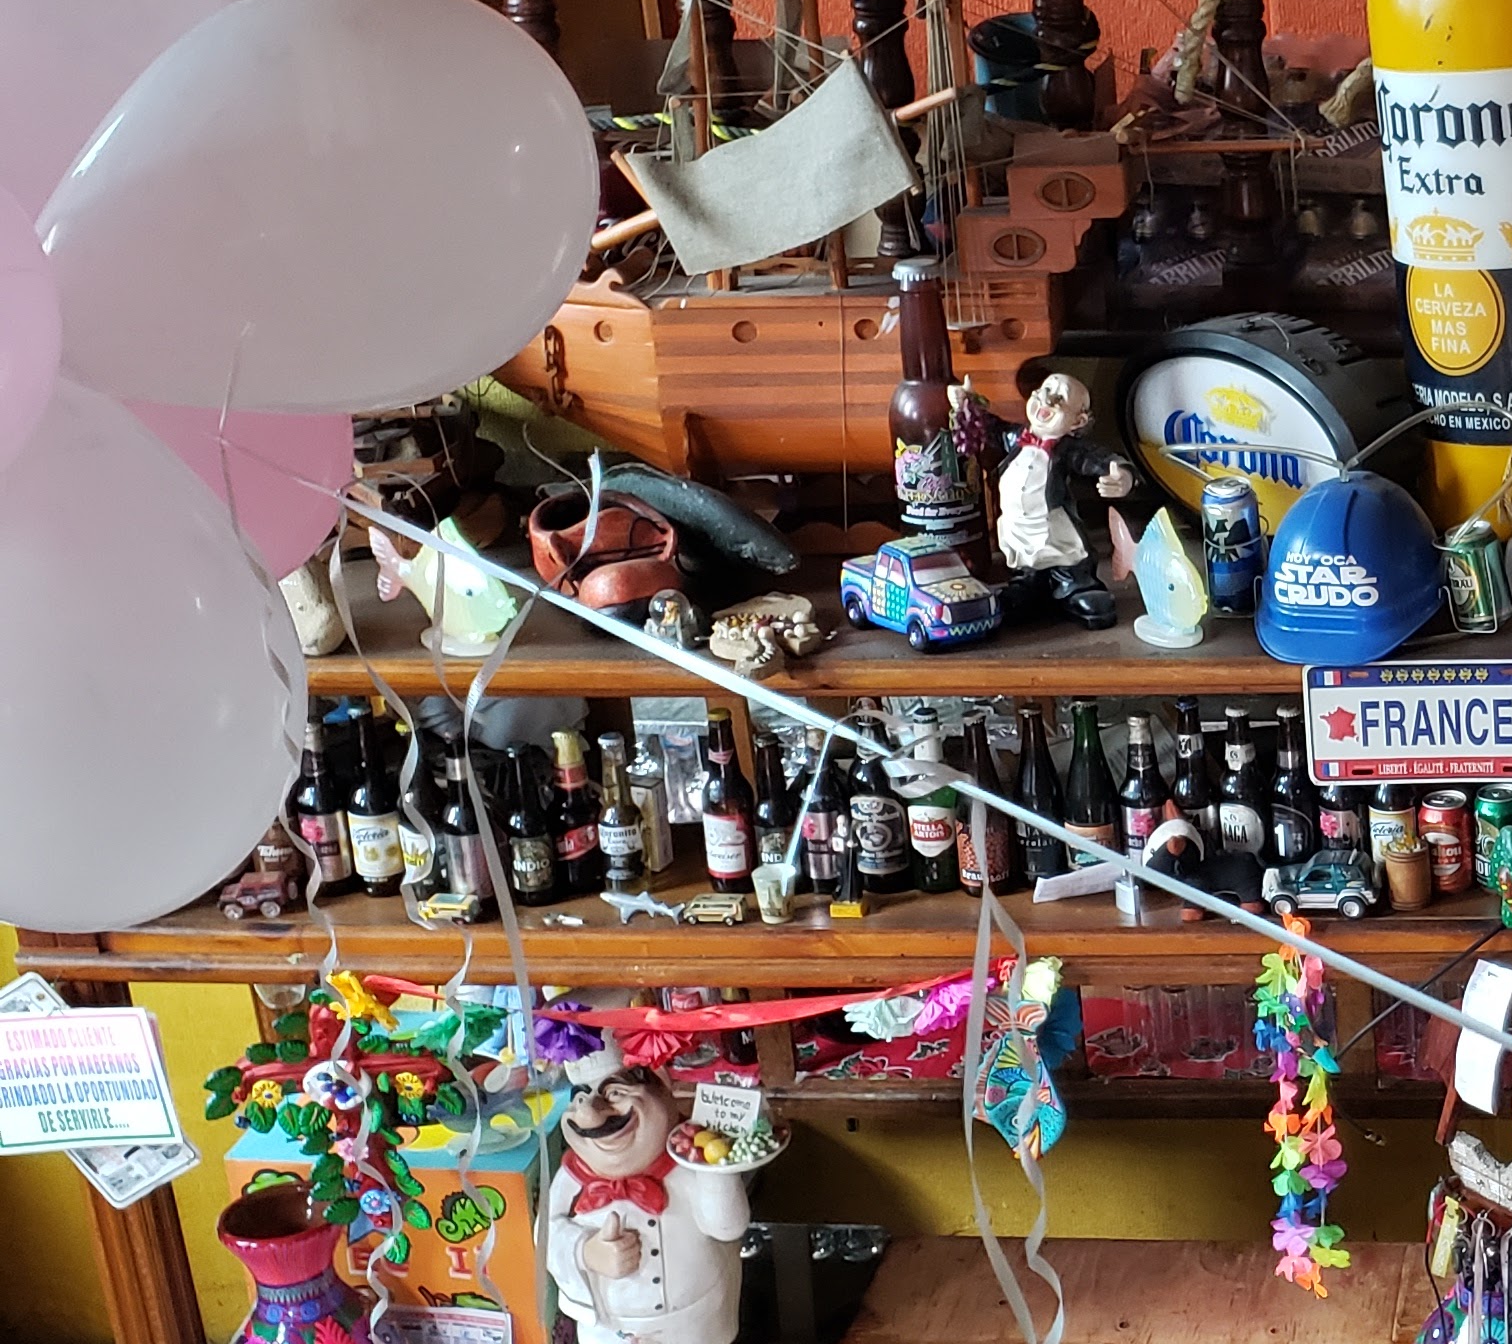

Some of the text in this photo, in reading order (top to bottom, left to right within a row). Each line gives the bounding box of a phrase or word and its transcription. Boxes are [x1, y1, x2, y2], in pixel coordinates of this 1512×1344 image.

[1397, 155, 1486, 196] Extra
[1434, 283, 1454, 298] LA
[1414, 297, 1487, 318] CERVEZA
[1431, 321, 1468, 336] MAS
[1431, 337, 1471, 355] FINA
[1449, 415, 1462, 429] EN
[1465, 416, 1511, 431] MEXICO
[1164, 409, 1303, 490] Corona
[1285, 551, 1312, 565] HOY
[1274, 561, 1378, 586] STAR
[1274, 581, 1380, 607] CRUDO
[913, 821, 944, 832] STELLA
[914, 830, 946, 840] ARTOIS
[513, 857, 550, 873] INDIO
[5, 1025, 117, 1051] ESTIMADO CLIENTE
[50, 1055, 77, 1077] POR
[77, 1053, 141, 1075] HABERNOS
[57, 1081, 76, 1104] LA
[74, 1079, 158, 1103] OPORTUNIDAD
[38, 1110, 58, 1133] DE
